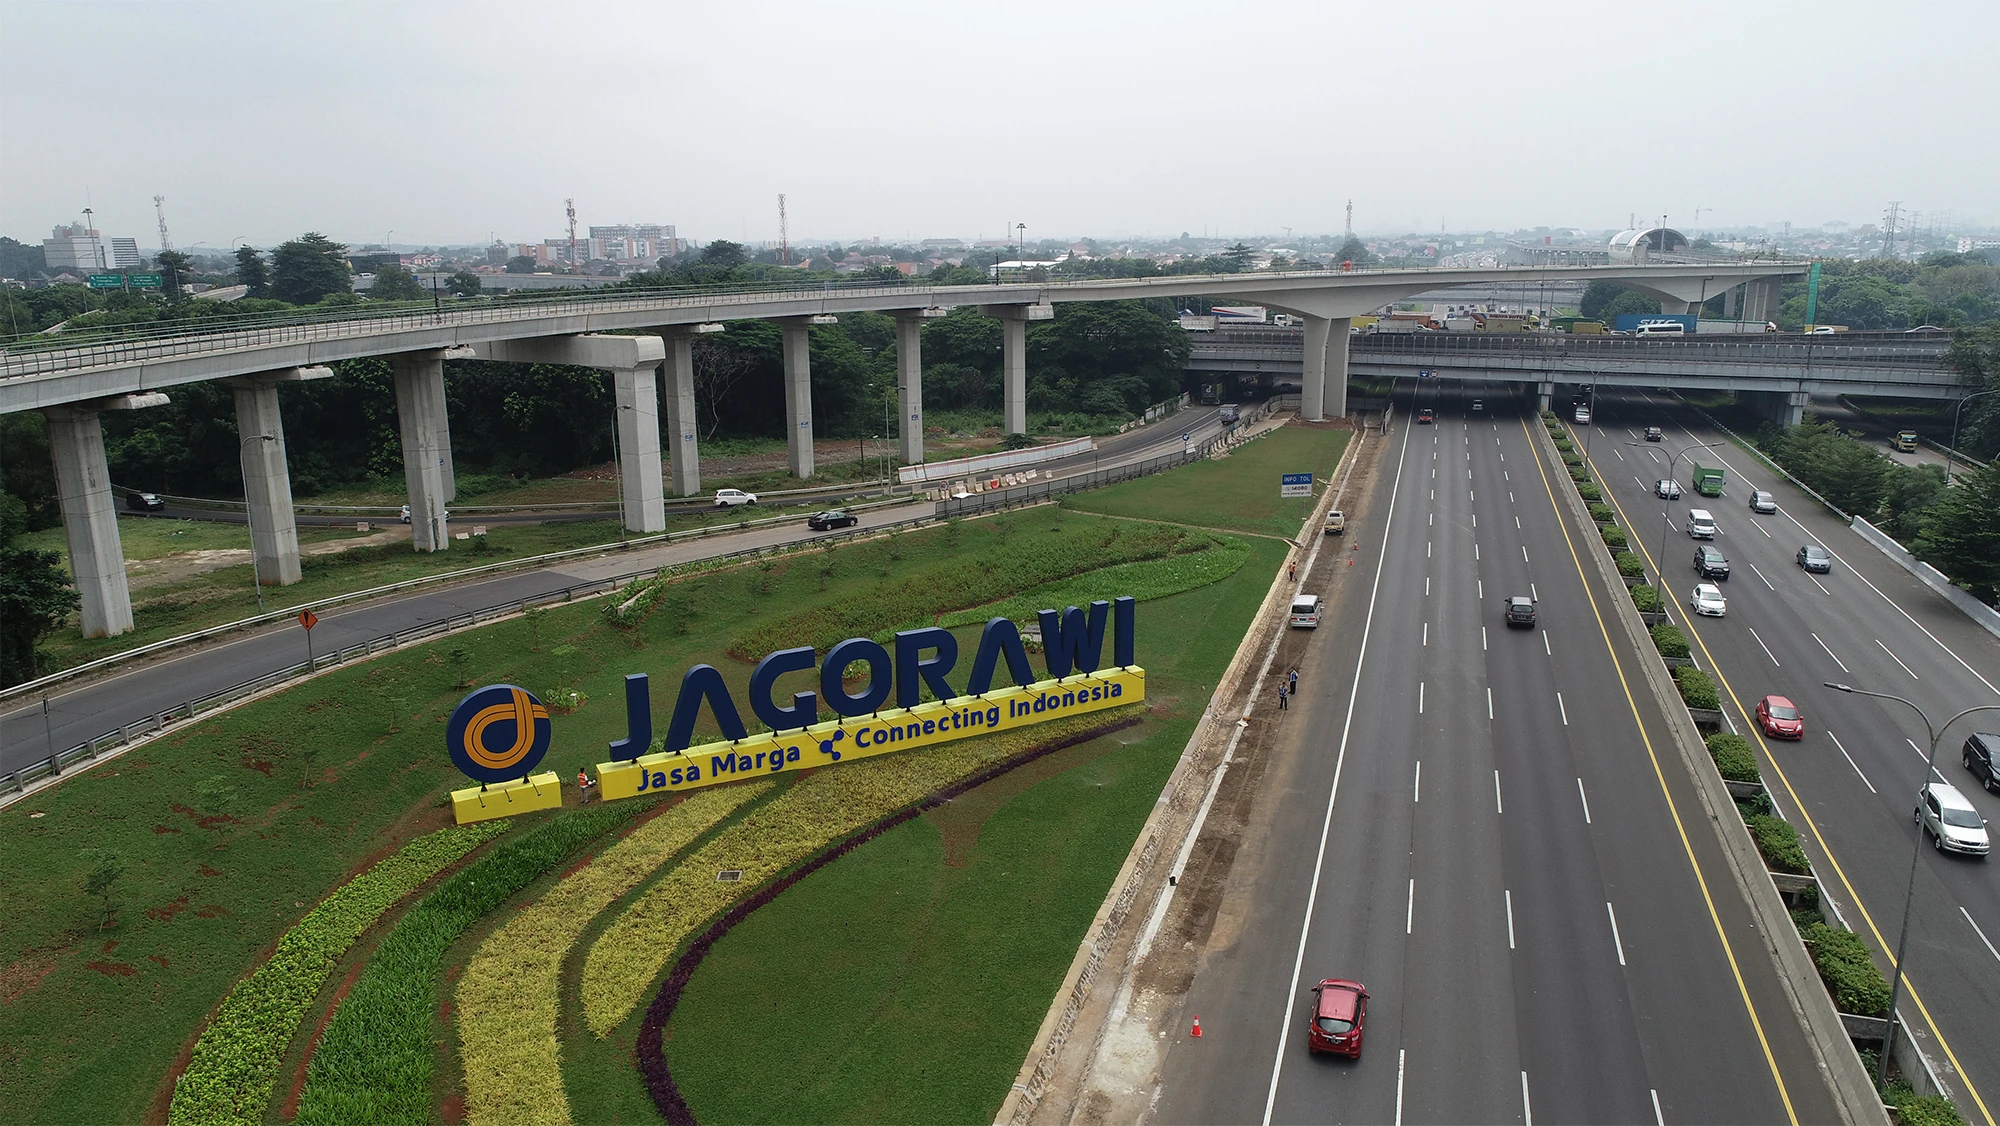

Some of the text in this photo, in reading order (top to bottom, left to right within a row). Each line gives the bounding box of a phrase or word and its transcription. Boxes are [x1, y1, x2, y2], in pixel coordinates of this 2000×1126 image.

[609, 596, 1135, 763] JAGORAWI
[637, 680, 1122, 792] Jasa Marga Connecting Indonesia
